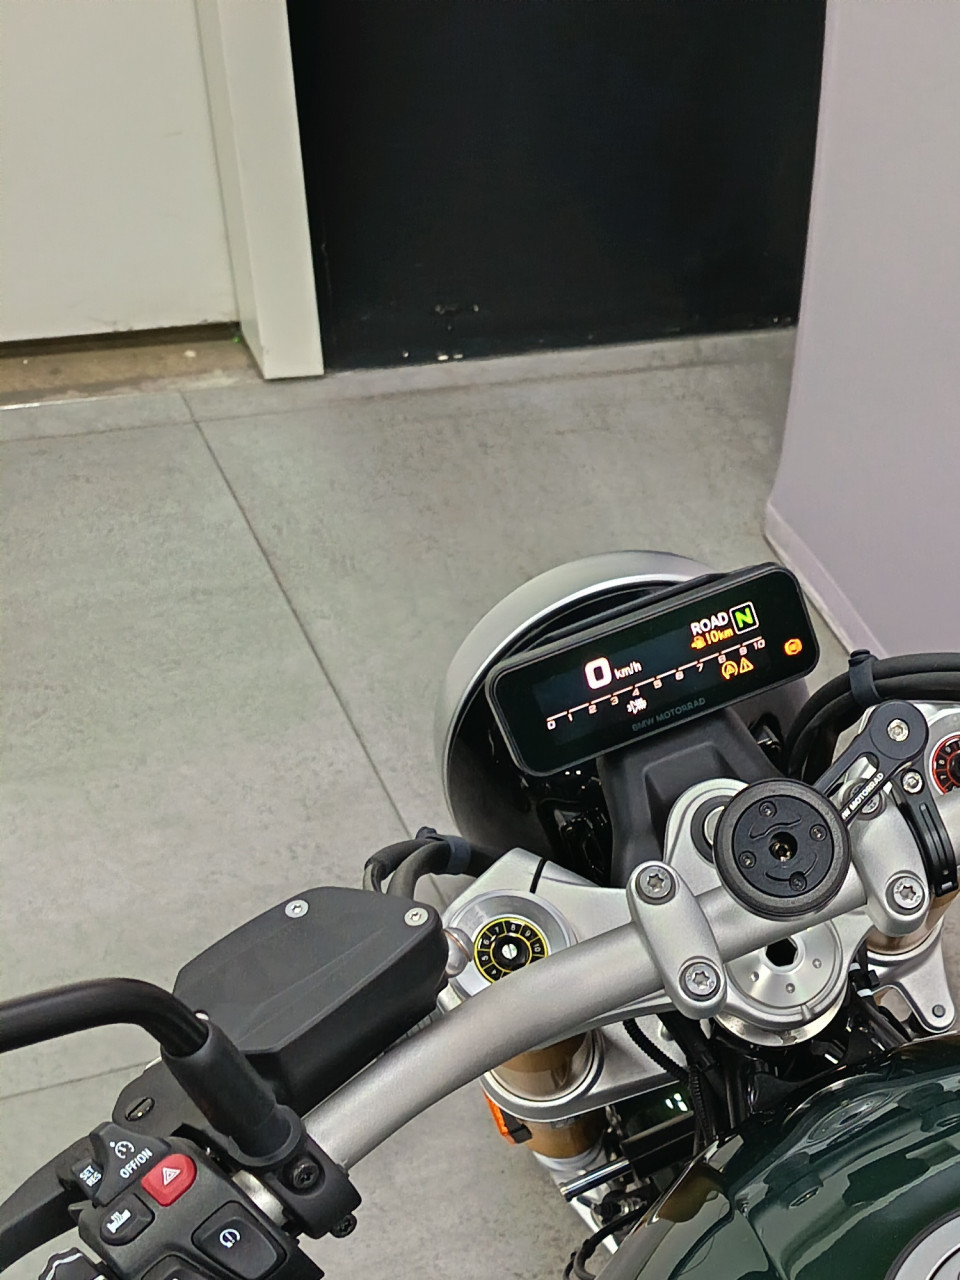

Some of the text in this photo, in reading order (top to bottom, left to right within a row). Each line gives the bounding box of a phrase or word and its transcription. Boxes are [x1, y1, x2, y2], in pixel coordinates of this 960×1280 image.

[690, 607, 754, 636] ROAD N
[585, 657, 642, 690] 0 km/h
[588, 704, 597, 715] 2
[610, 695, 619, 706] 3
[696, 662, 704, 672] 7
[753, 639, 766, 651] 10
[632, 697, 706, 731] BMW MOTORRAD
[849, 772, 884, 811] MOTORRAD
[80, 1165, 94, 1181] SET
[86, 1171, 102, 1187] RES
[120, 1147, 153, 1179] OFF/ON
